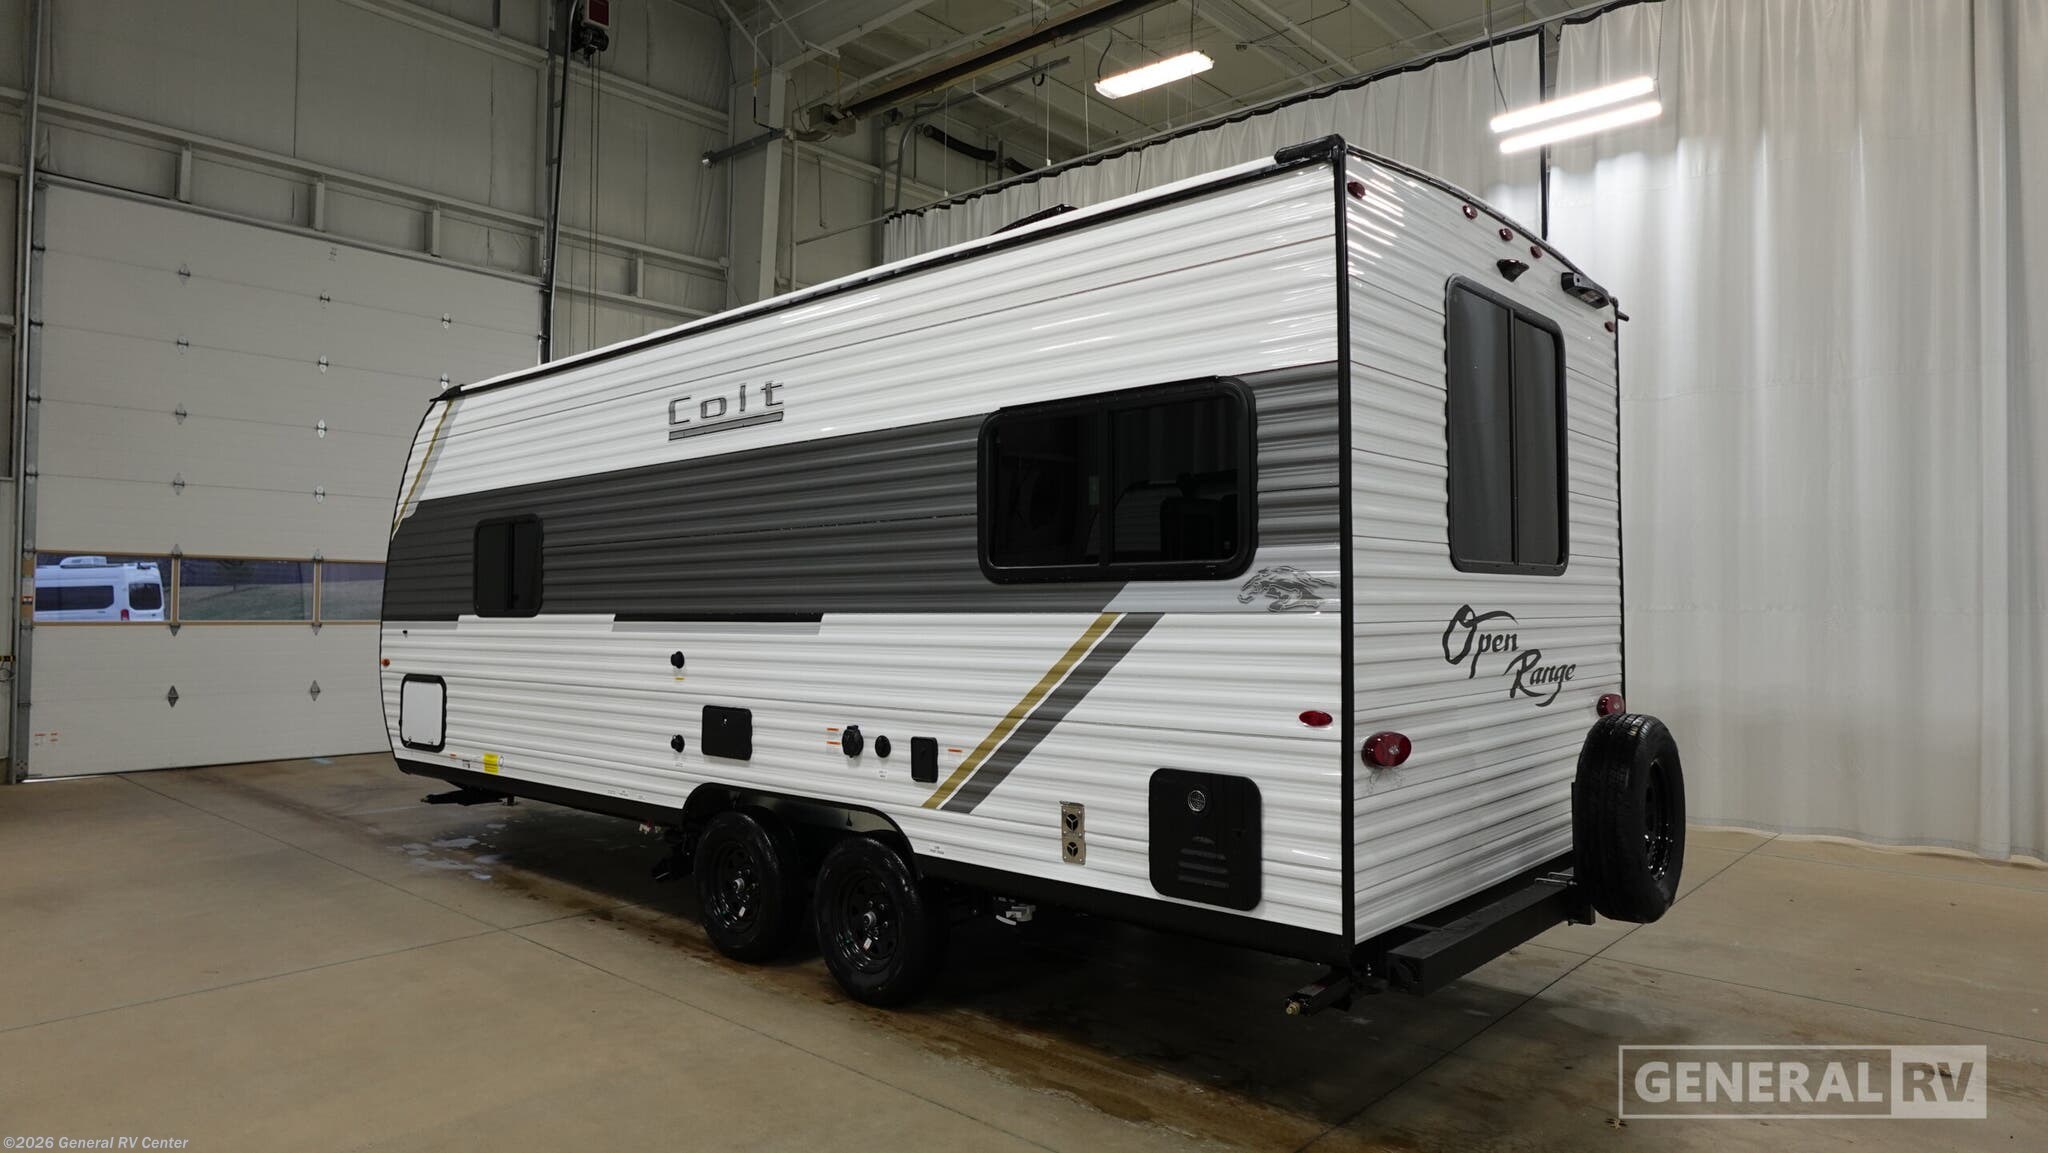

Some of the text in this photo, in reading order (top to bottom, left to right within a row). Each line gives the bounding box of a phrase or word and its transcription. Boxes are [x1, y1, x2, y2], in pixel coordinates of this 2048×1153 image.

[668, 382, 784, 425] Colt
[1442, 603, 1519, 679] Open
[1503, 649, 1577, 708] Range
